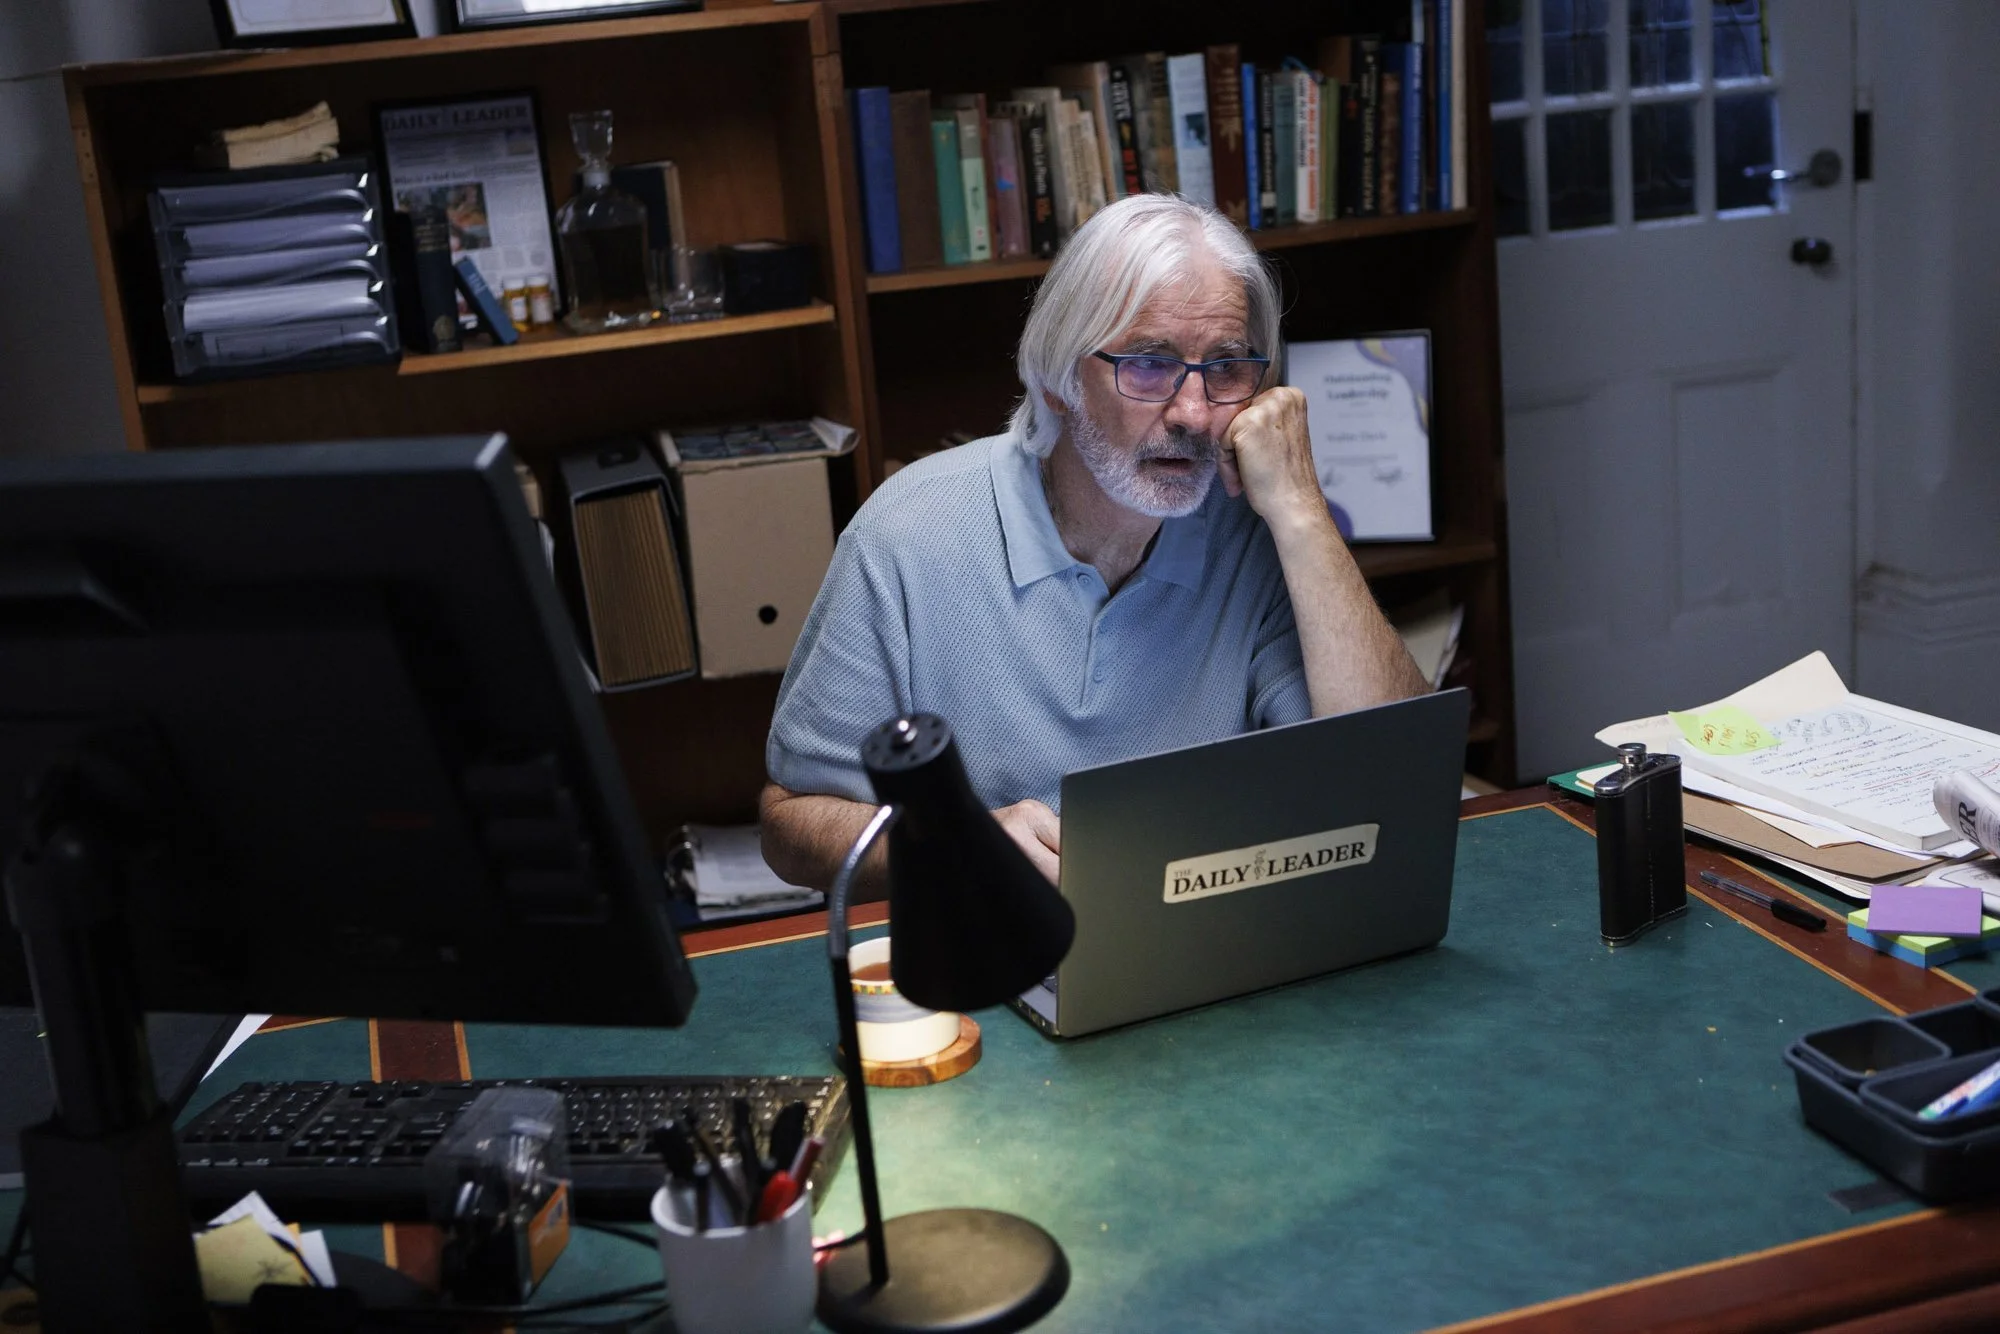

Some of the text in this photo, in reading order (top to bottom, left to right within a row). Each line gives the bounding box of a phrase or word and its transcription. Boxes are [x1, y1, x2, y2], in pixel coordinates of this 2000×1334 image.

[384, 106, 528, 130] DAILY LEADER
[1173, 841, 1366, 896] DAILY LEADER
[1174, 868, 1193, 878] THE
